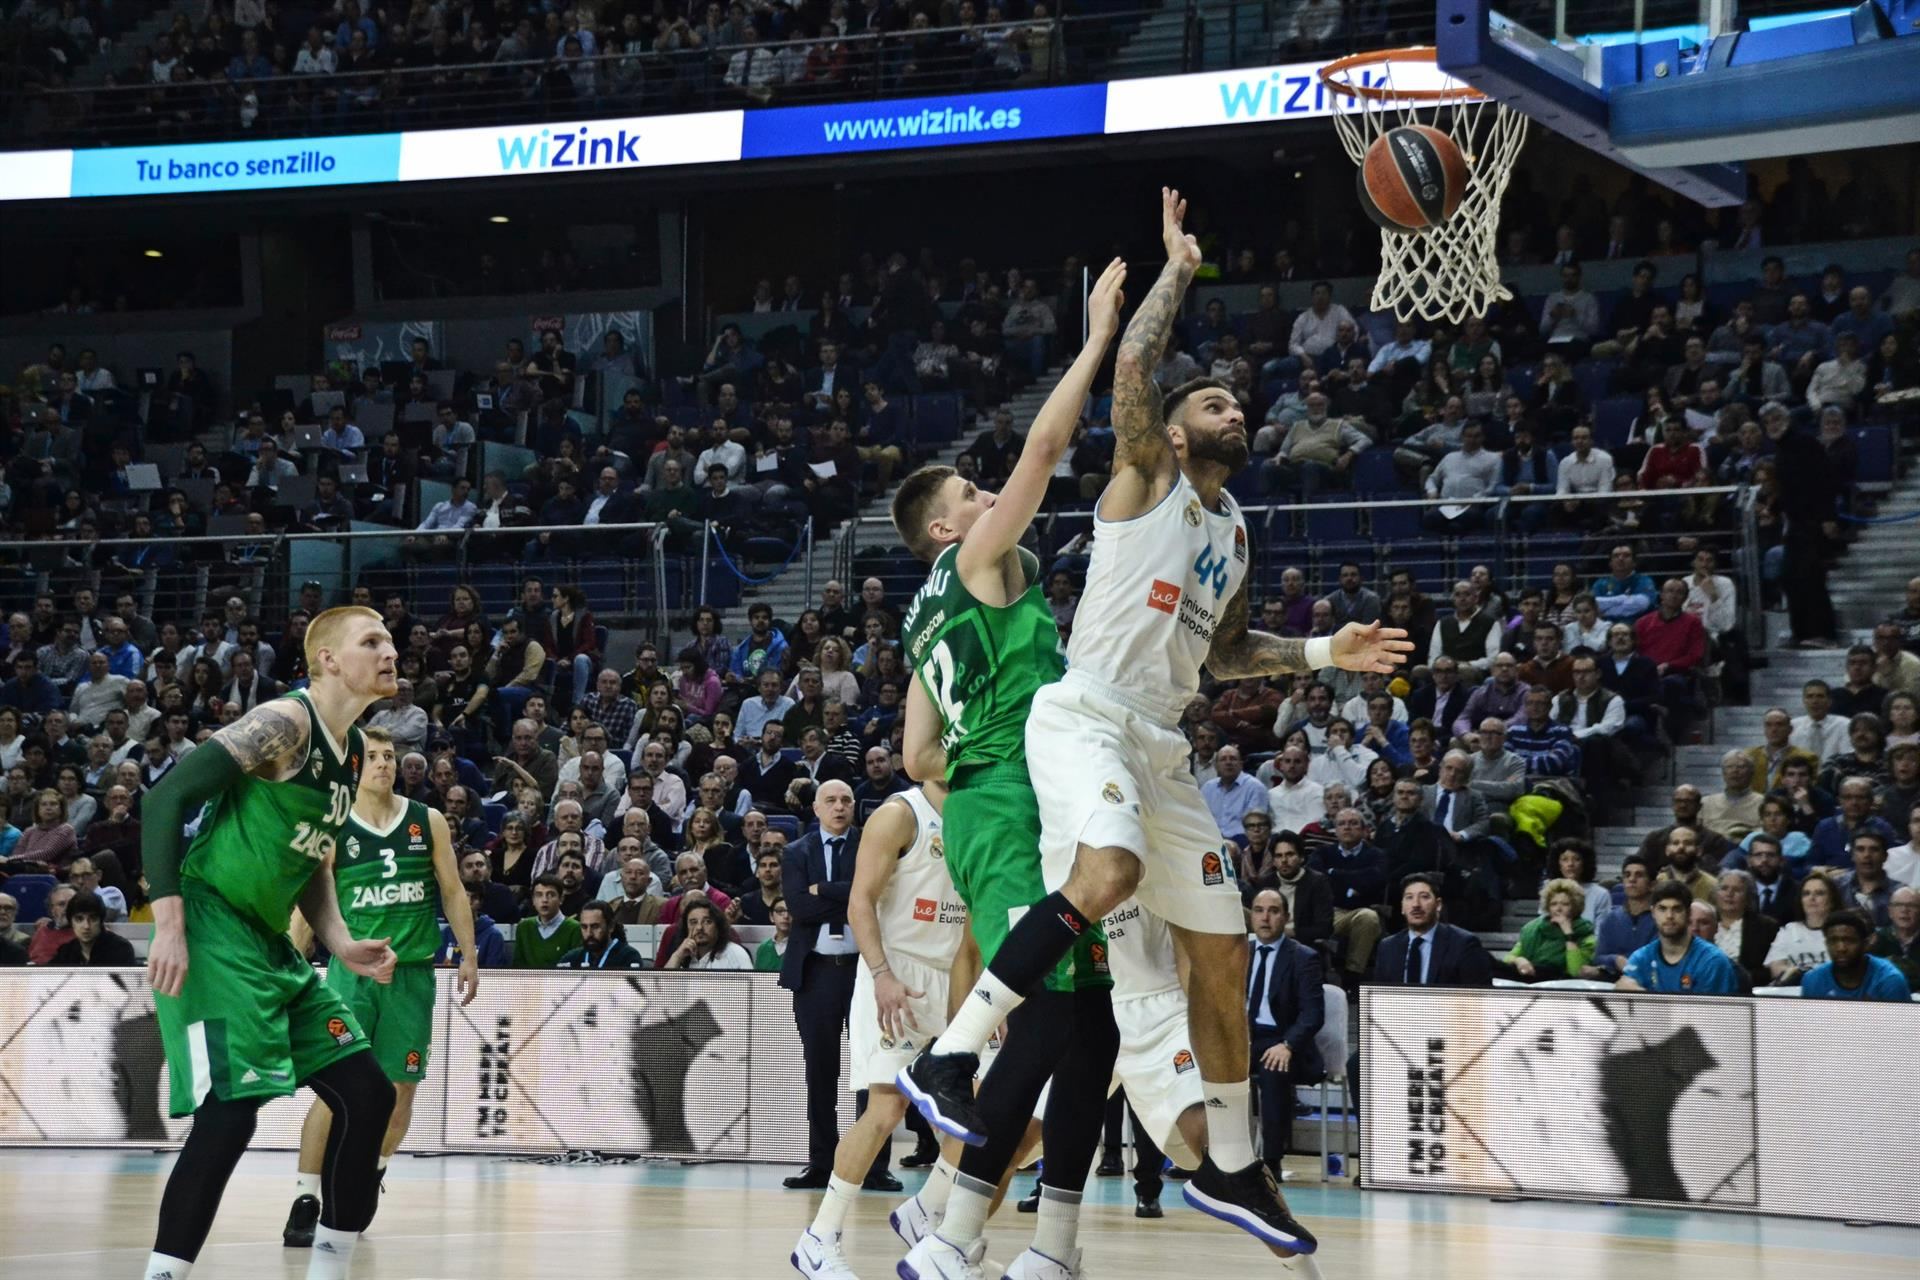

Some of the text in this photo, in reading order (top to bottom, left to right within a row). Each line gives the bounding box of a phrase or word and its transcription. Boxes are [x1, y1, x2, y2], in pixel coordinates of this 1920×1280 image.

[824, 105, 1021, 143] www.wizink.es
[498, 127, 641, 170] WiZink
[136, 159, 160, 183] Tu
[168, 154, 239, 181] banco
[1194, 542, 1229, 601] 44
[322, 781, 351, 827] 30
[379, 848, 398, 878] 3
[1101, 904, 1140, 928] rsidad
[492, 1108, 508, 1136] TO
[1427, 1038, 1446, 1176] TO CREATE
